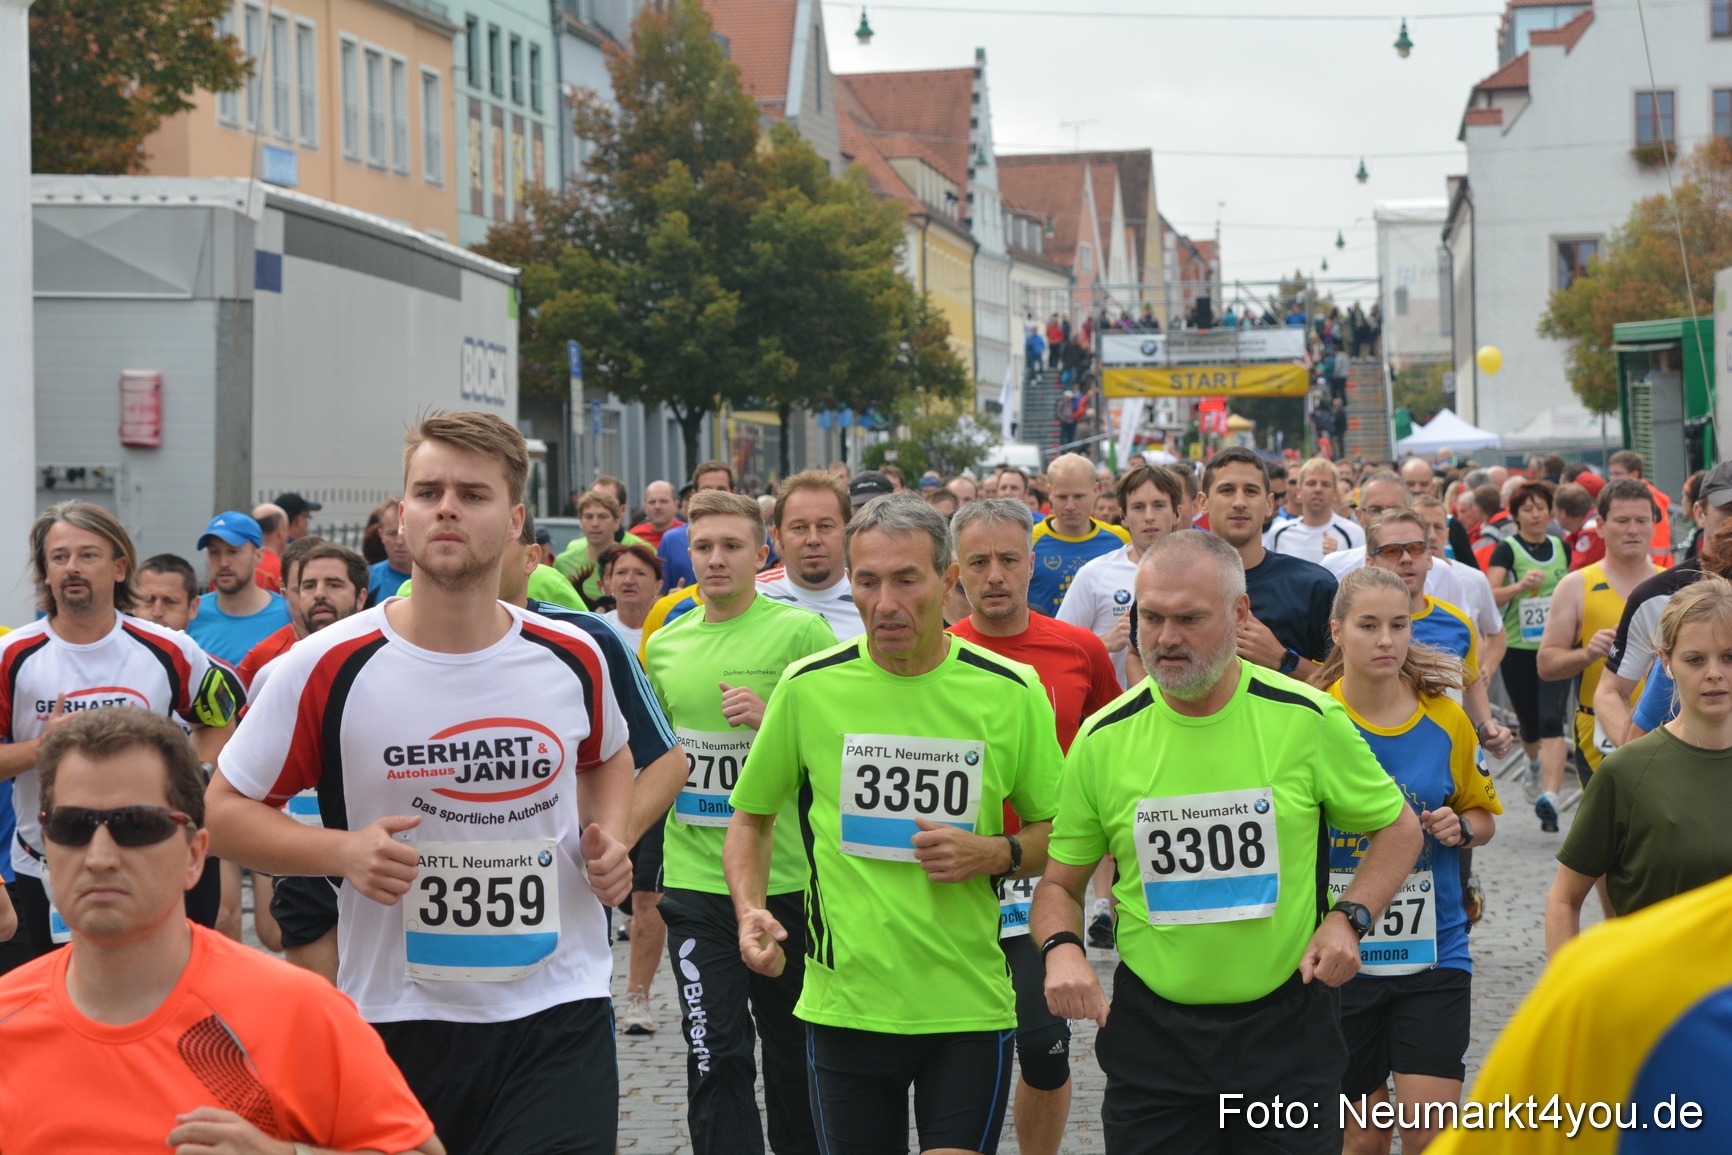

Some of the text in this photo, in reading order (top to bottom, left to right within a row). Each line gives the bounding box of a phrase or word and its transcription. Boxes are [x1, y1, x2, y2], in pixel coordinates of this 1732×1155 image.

[461, 337, 507, 405] BOCK
[1170, 372, 1239, 389] START
[1525, 608, 1549, 625] 23
[383, 736, 548, 767] GERHART &
[702, 741, 750, 750] Neumarkt
[846, 745, 959, 763] PARTL Neumarkt
[387, 766, 455, 780] Autohaus
[455, 759, 551, 784] JÄNIG
[684, 752, 748, 790] 270
[854, 764, 969, 816] 3350
[411, 794, 559, 825] Das sportliche Autohaus
[1137, 803, 1249, 822] PARTL Neumarkt
[1148, 821, 1265, 874] 3308
[416, 855, 533, 869] ARTL Neumarkt
[419, 874, 545, 928] 3359
[1002, 909, 1027, 924] oche
[1368, 898, 1426, 936] 57
[1361, 949, 1409, 961] amona
